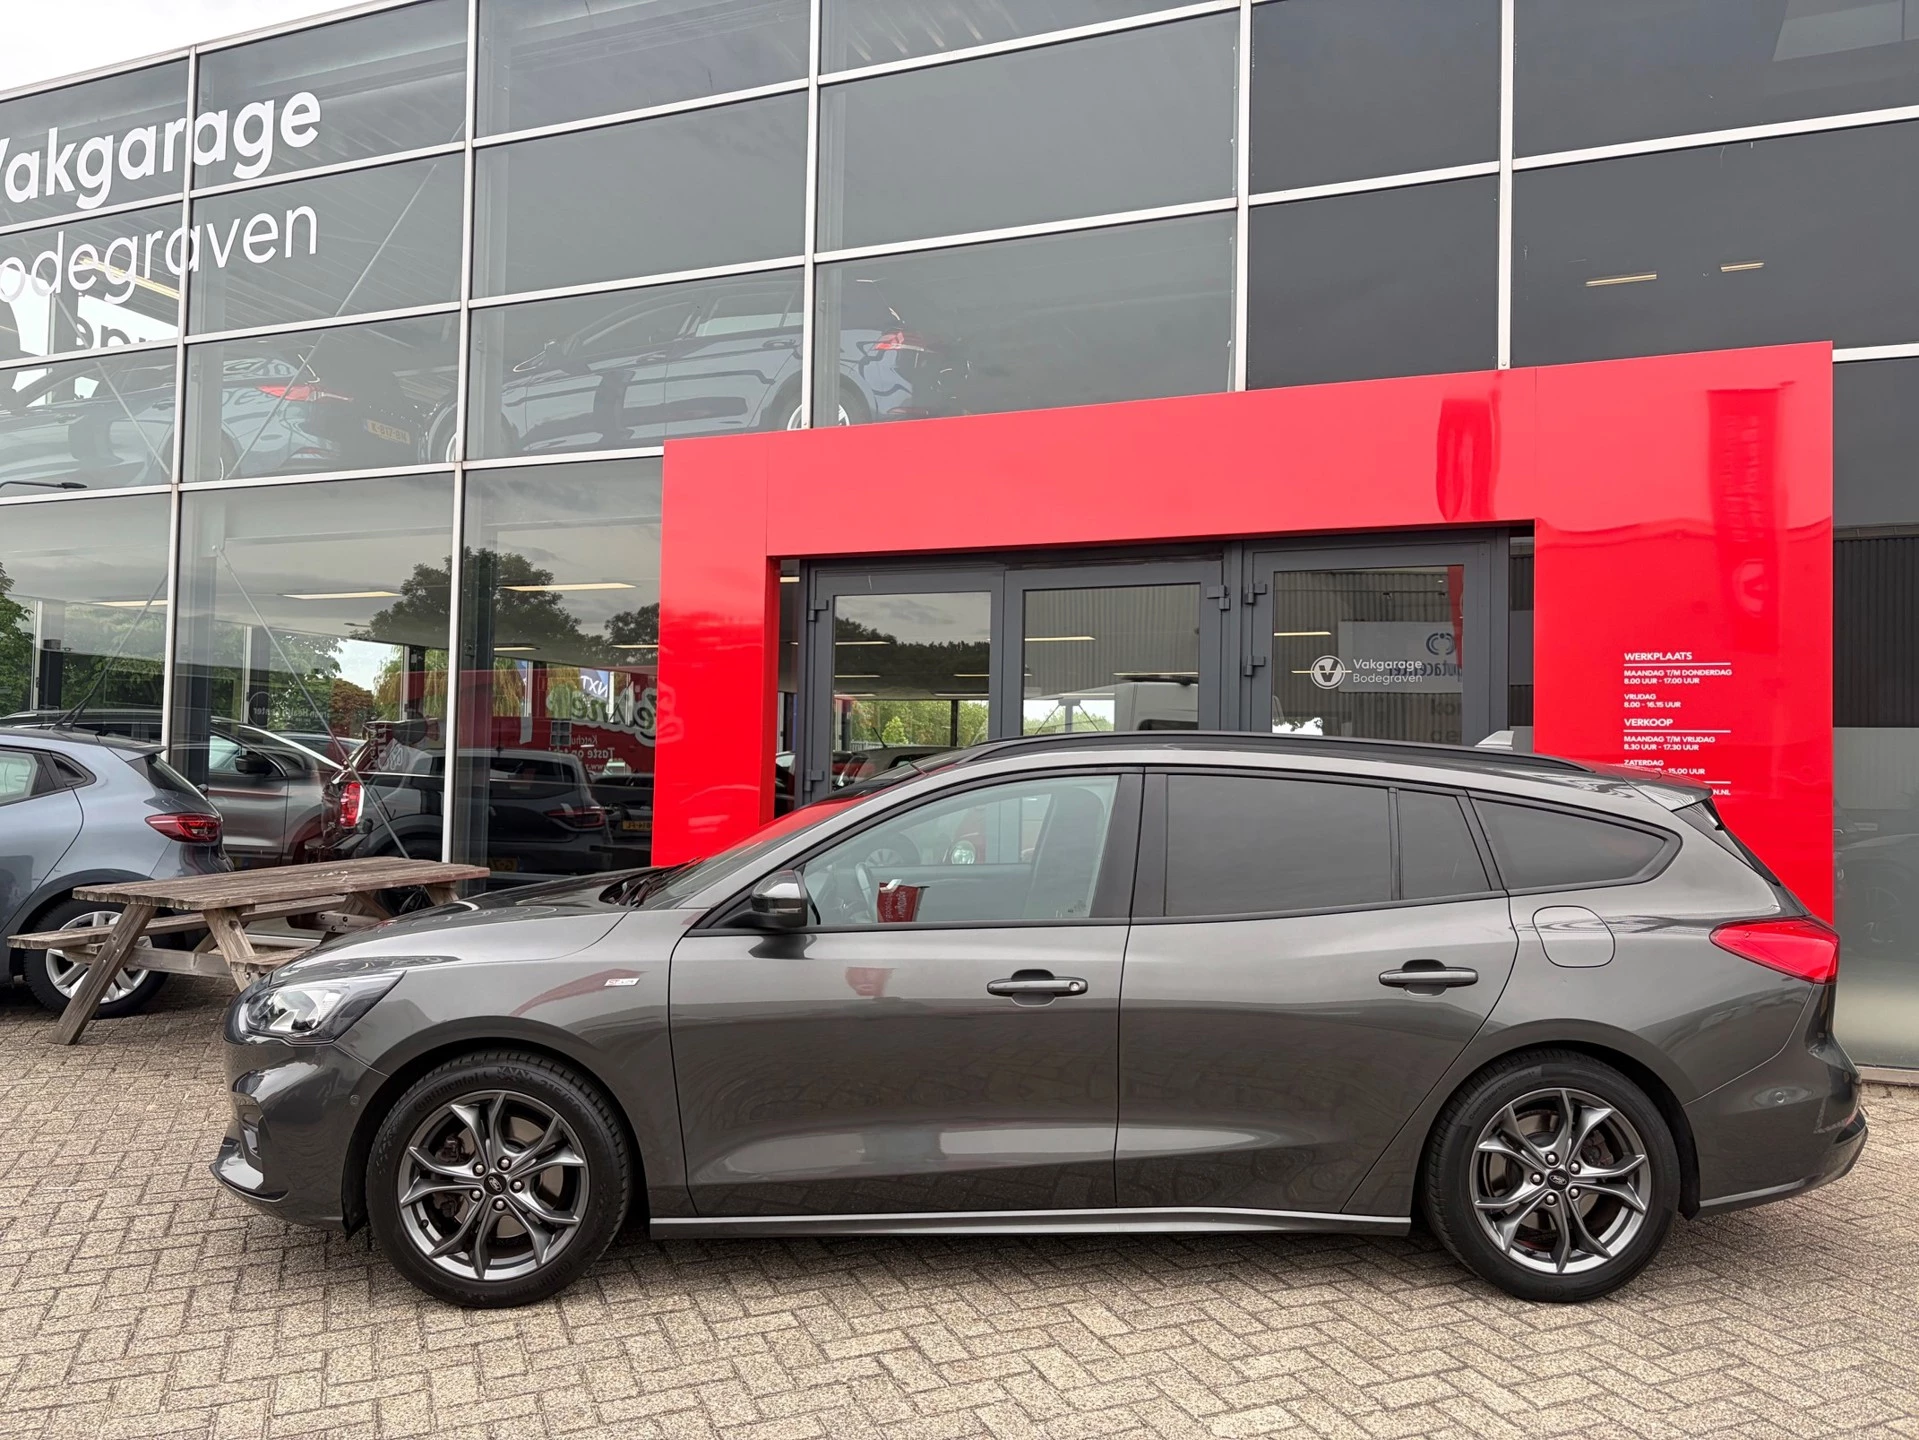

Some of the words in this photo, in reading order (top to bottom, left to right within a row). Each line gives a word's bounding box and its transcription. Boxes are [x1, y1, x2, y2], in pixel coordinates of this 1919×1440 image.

[1624, 652, 1692, 661] WERKPLAATS
[1353, 658, 1423, 671] Vakgarage
[1353, 673, 1423, 685] Bodegraven
[1624, 718, 1673, 726] VERKOOP
